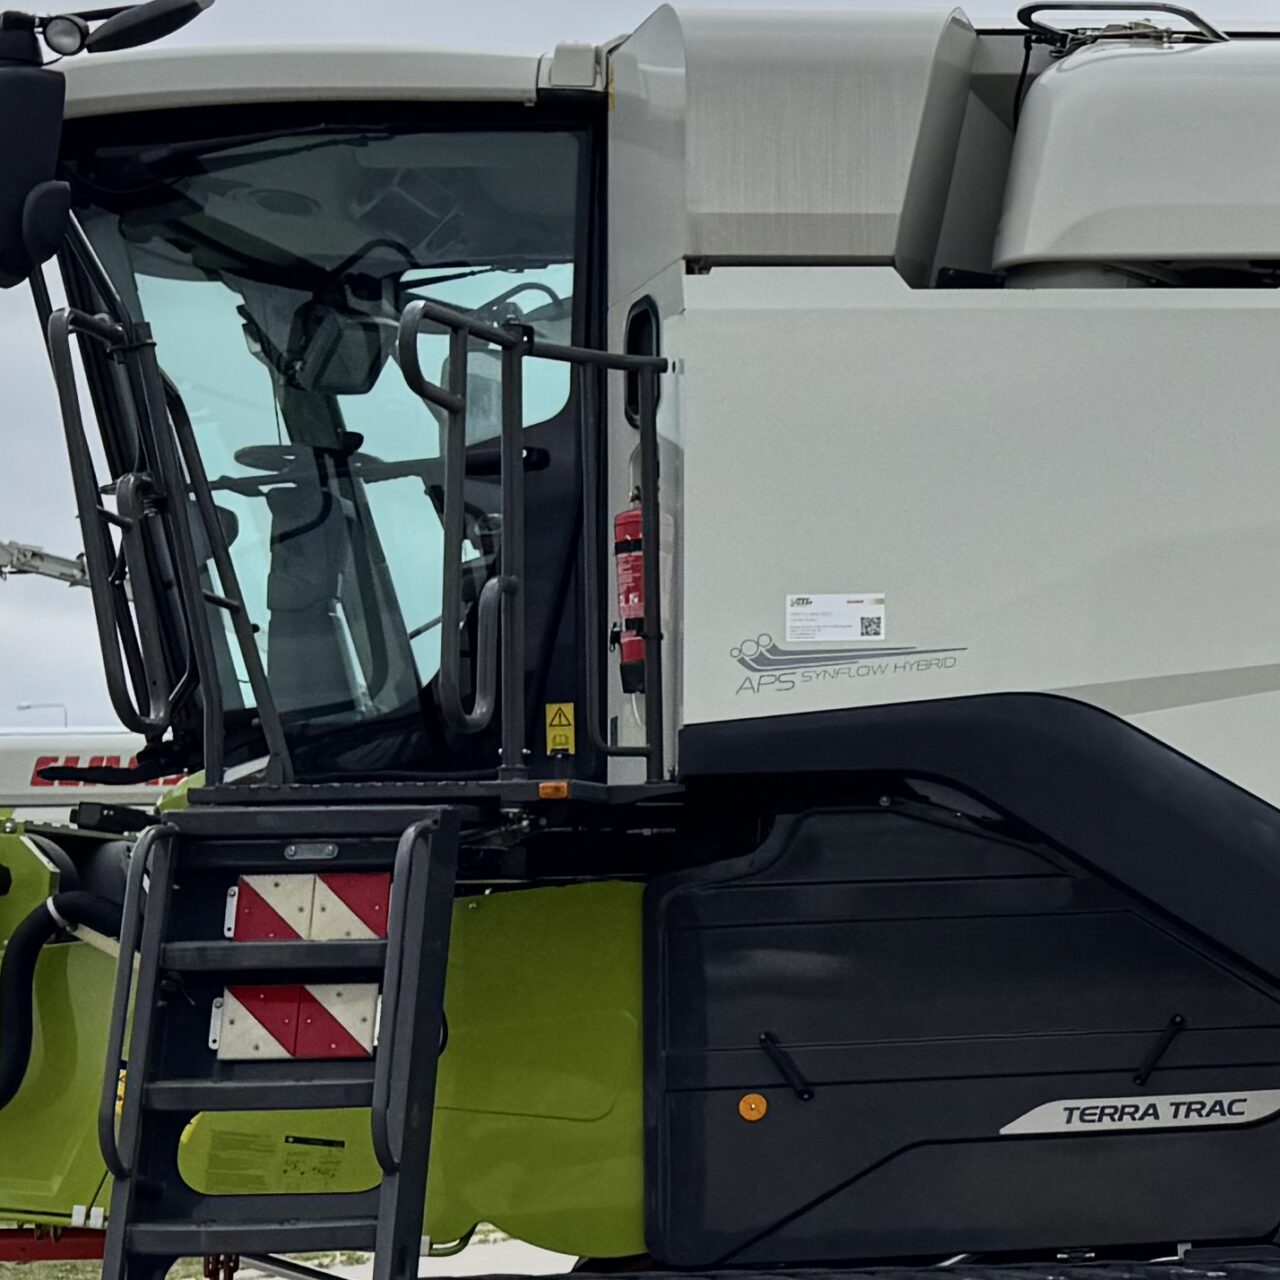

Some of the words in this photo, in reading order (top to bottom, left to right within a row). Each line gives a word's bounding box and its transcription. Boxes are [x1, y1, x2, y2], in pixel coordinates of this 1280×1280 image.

[735, 672, 797, 695] APS
[802, 663, 890, 683] SYNFLOW
[893, 656, 957, 672] HYBRID
[1062, 1103, 1160, 1125] TERRA
[1169, 1098, 1248, 1120] TRAC
